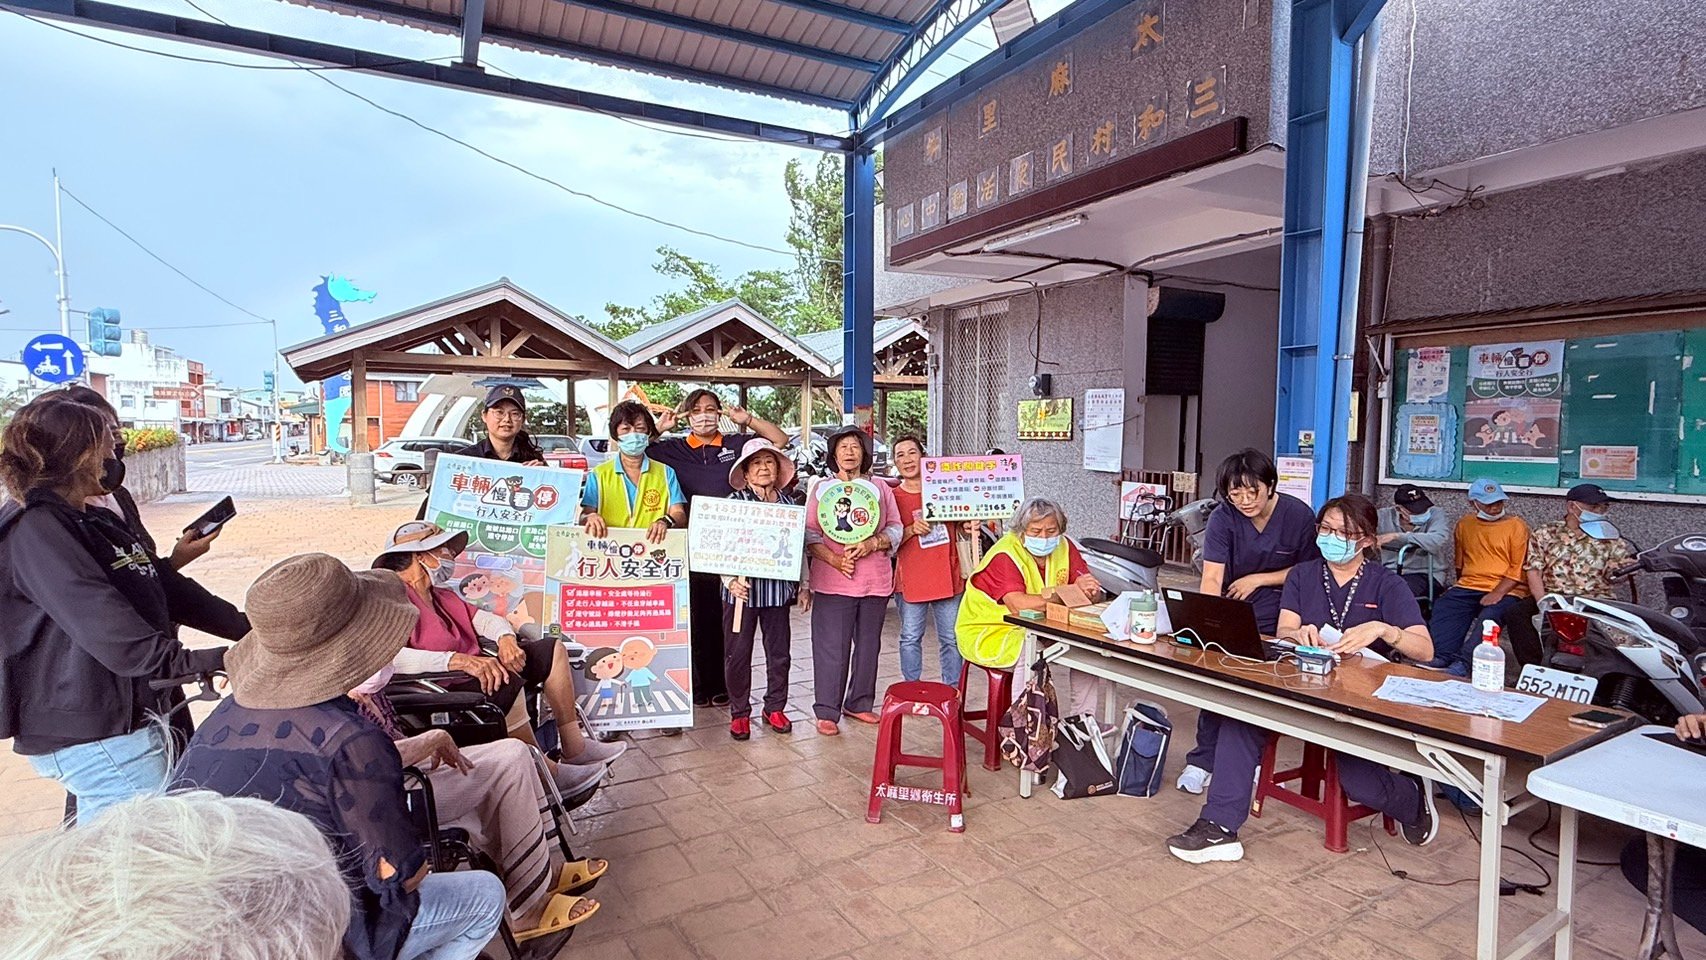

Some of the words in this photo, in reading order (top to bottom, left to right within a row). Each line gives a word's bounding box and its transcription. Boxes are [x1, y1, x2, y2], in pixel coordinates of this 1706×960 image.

[450, 473, 554, 507] 車輛慢看停
[476, 507, 534, 523] 行人安全行
[577, 556, 682, 578] 行人安全行
[777, 560, 793, 568] 165
[875, 783, 957, 806] 太麻里鄉衛生所
